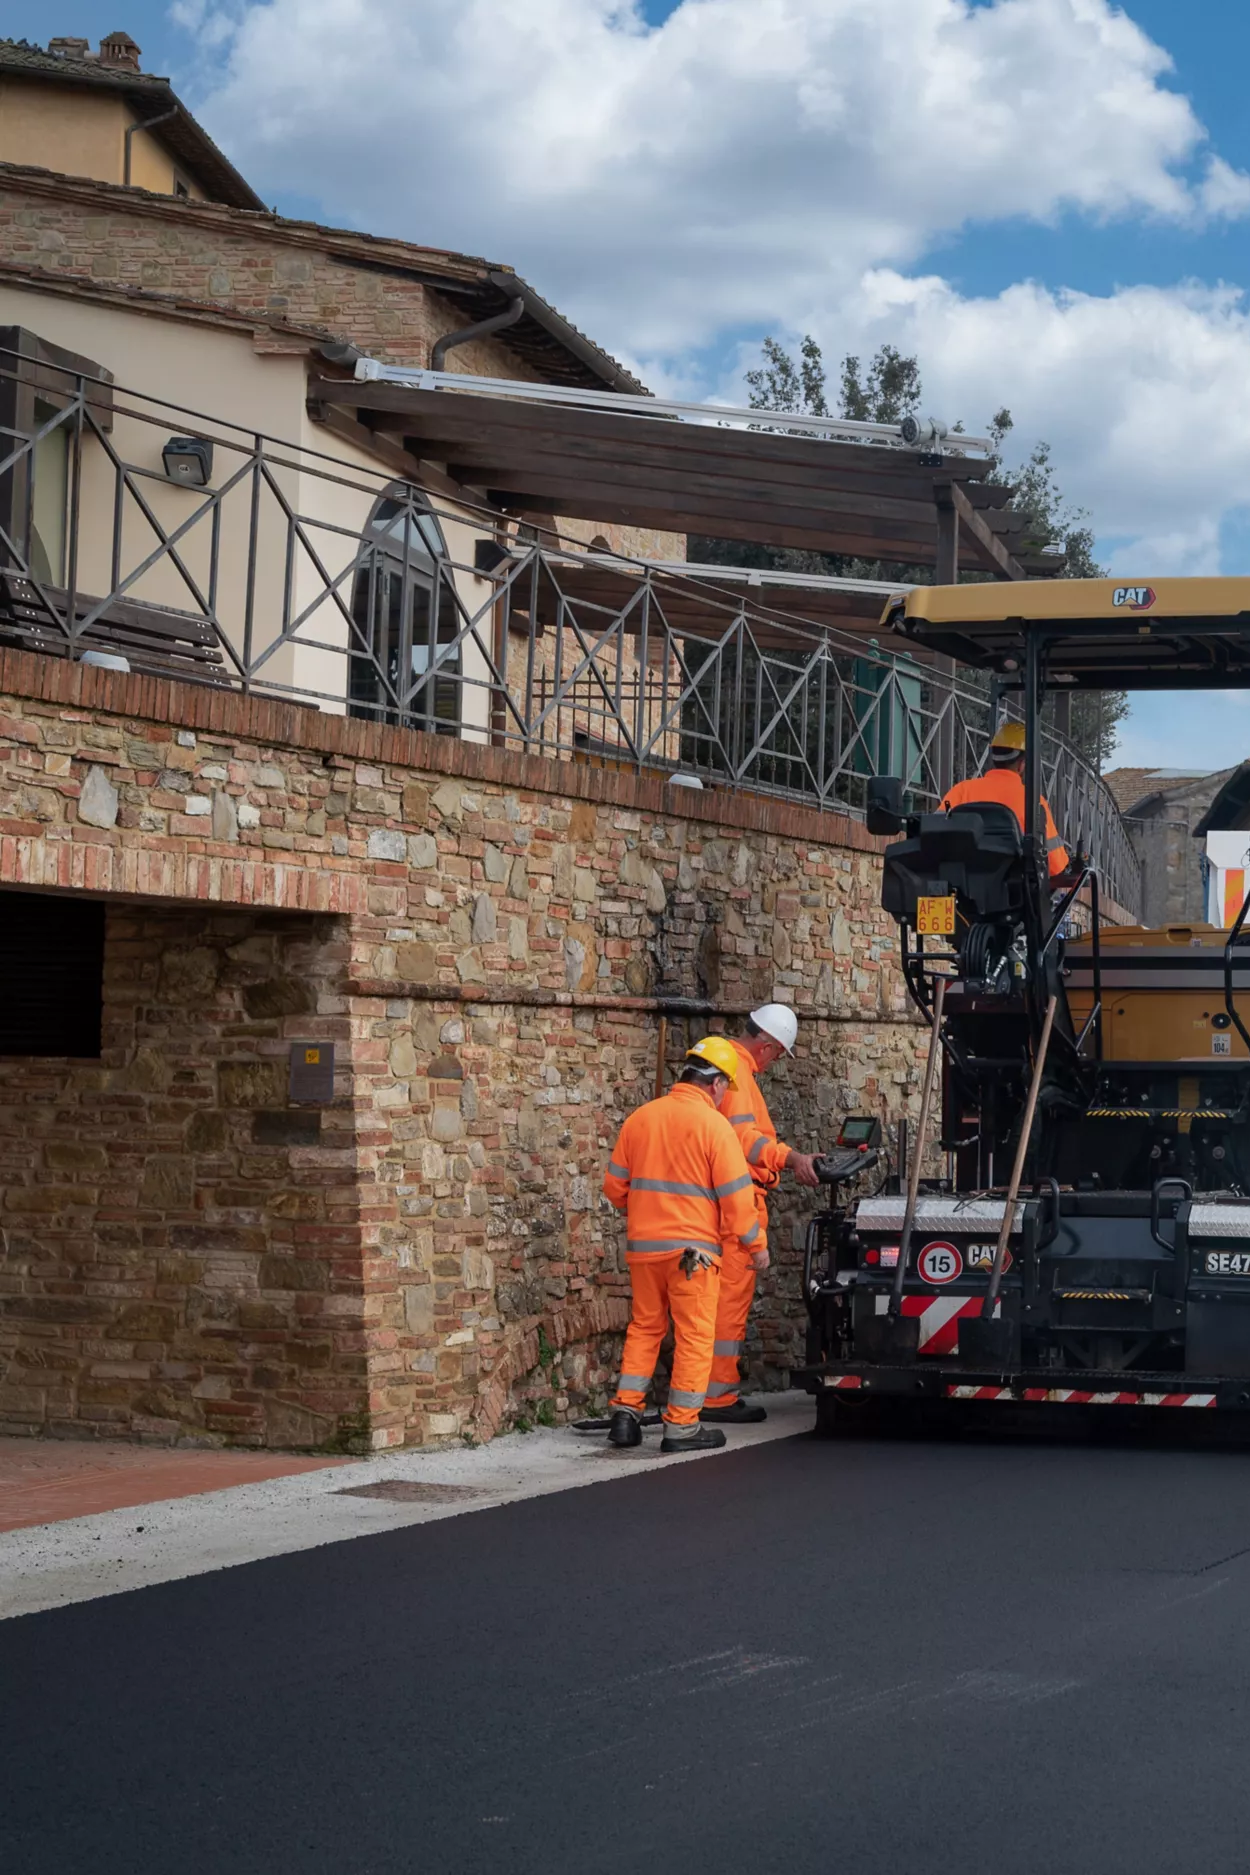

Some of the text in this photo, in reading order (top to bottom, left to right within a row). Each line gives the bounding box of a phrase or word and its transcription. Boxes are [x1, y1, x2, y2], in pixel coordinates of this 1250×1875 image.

[1113, 587, 1147, 606] CAT
[919, 899, 953, 914] AF W
[928, 1255, 951, 1273] 15
[968, 1244, 998, 1266] CAT
